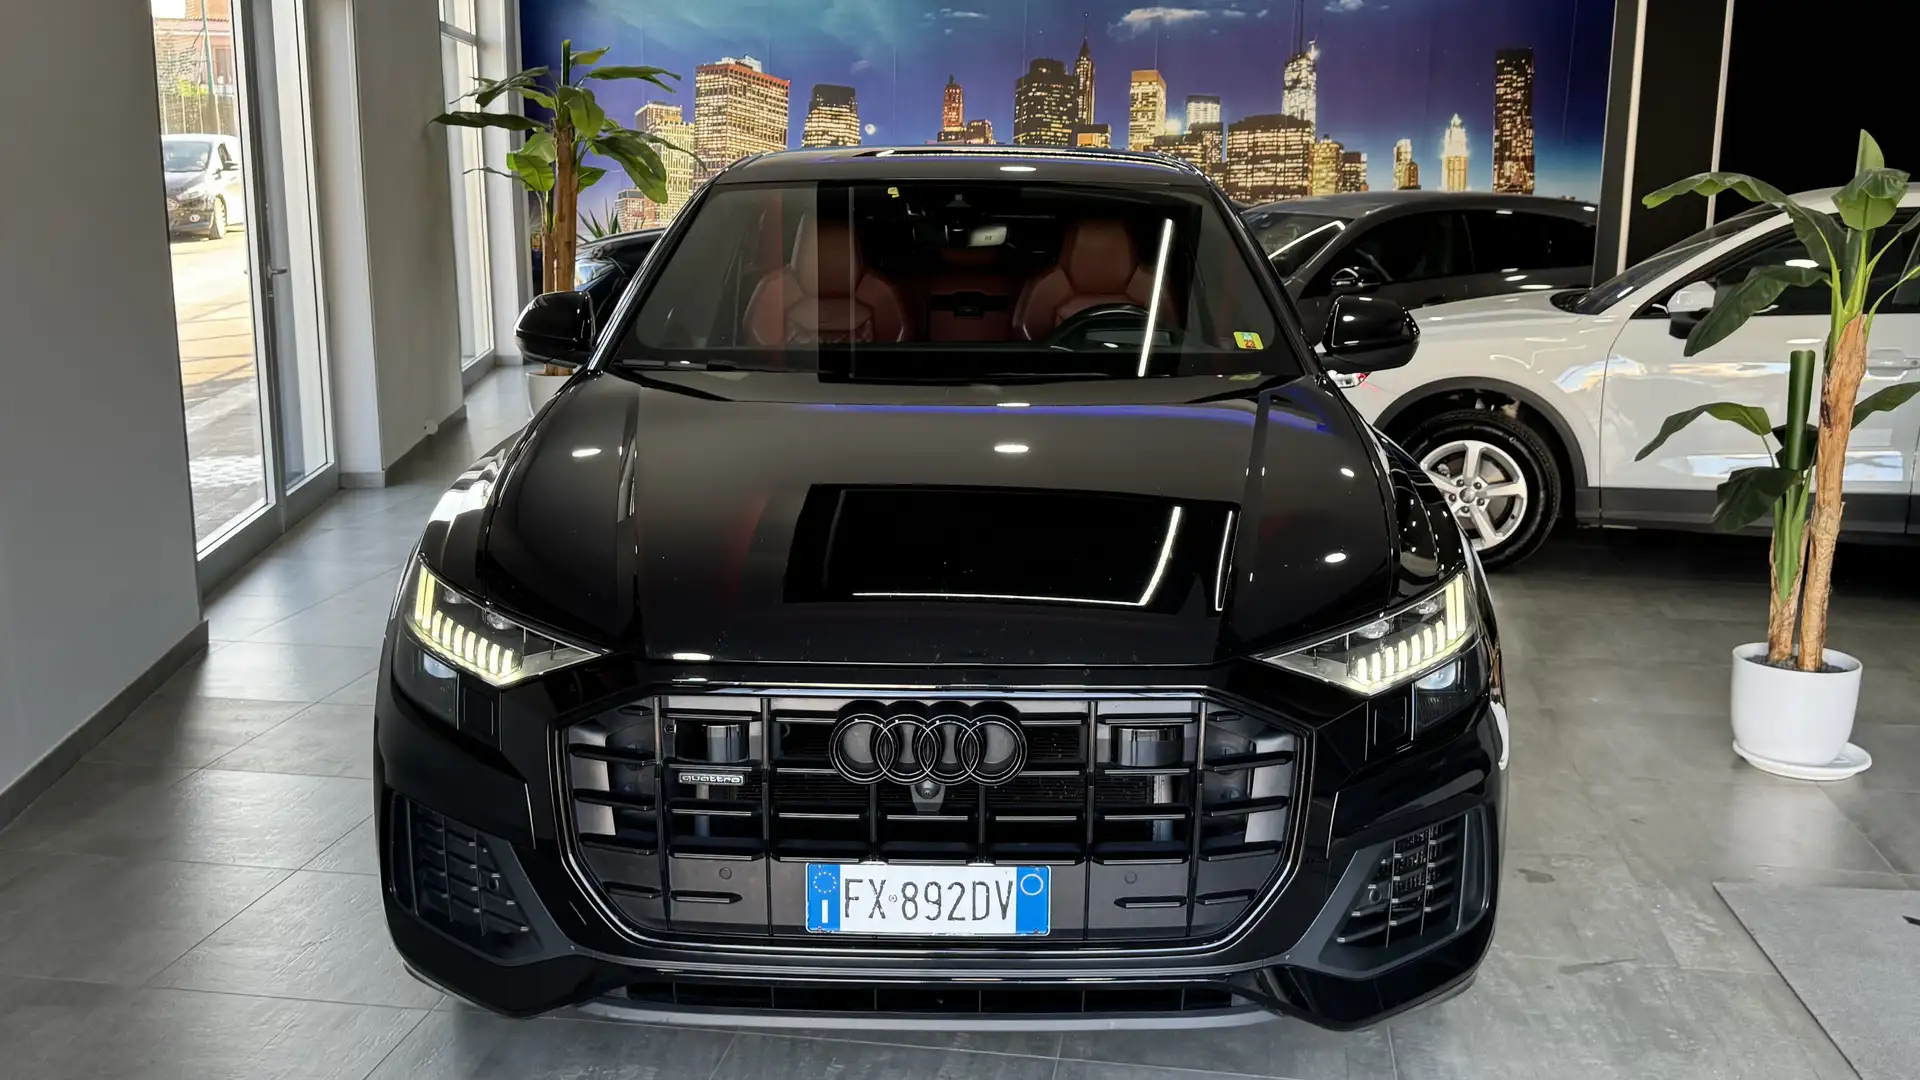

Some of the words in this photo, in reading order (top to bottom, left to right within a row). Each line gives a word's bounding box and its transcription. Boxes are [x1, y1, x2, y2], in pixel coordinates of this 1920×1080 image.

[678, 775, 740, 783] quattro
[844, 878, 886, 919] FX
[900, 880, 1013, 921] 892DV
